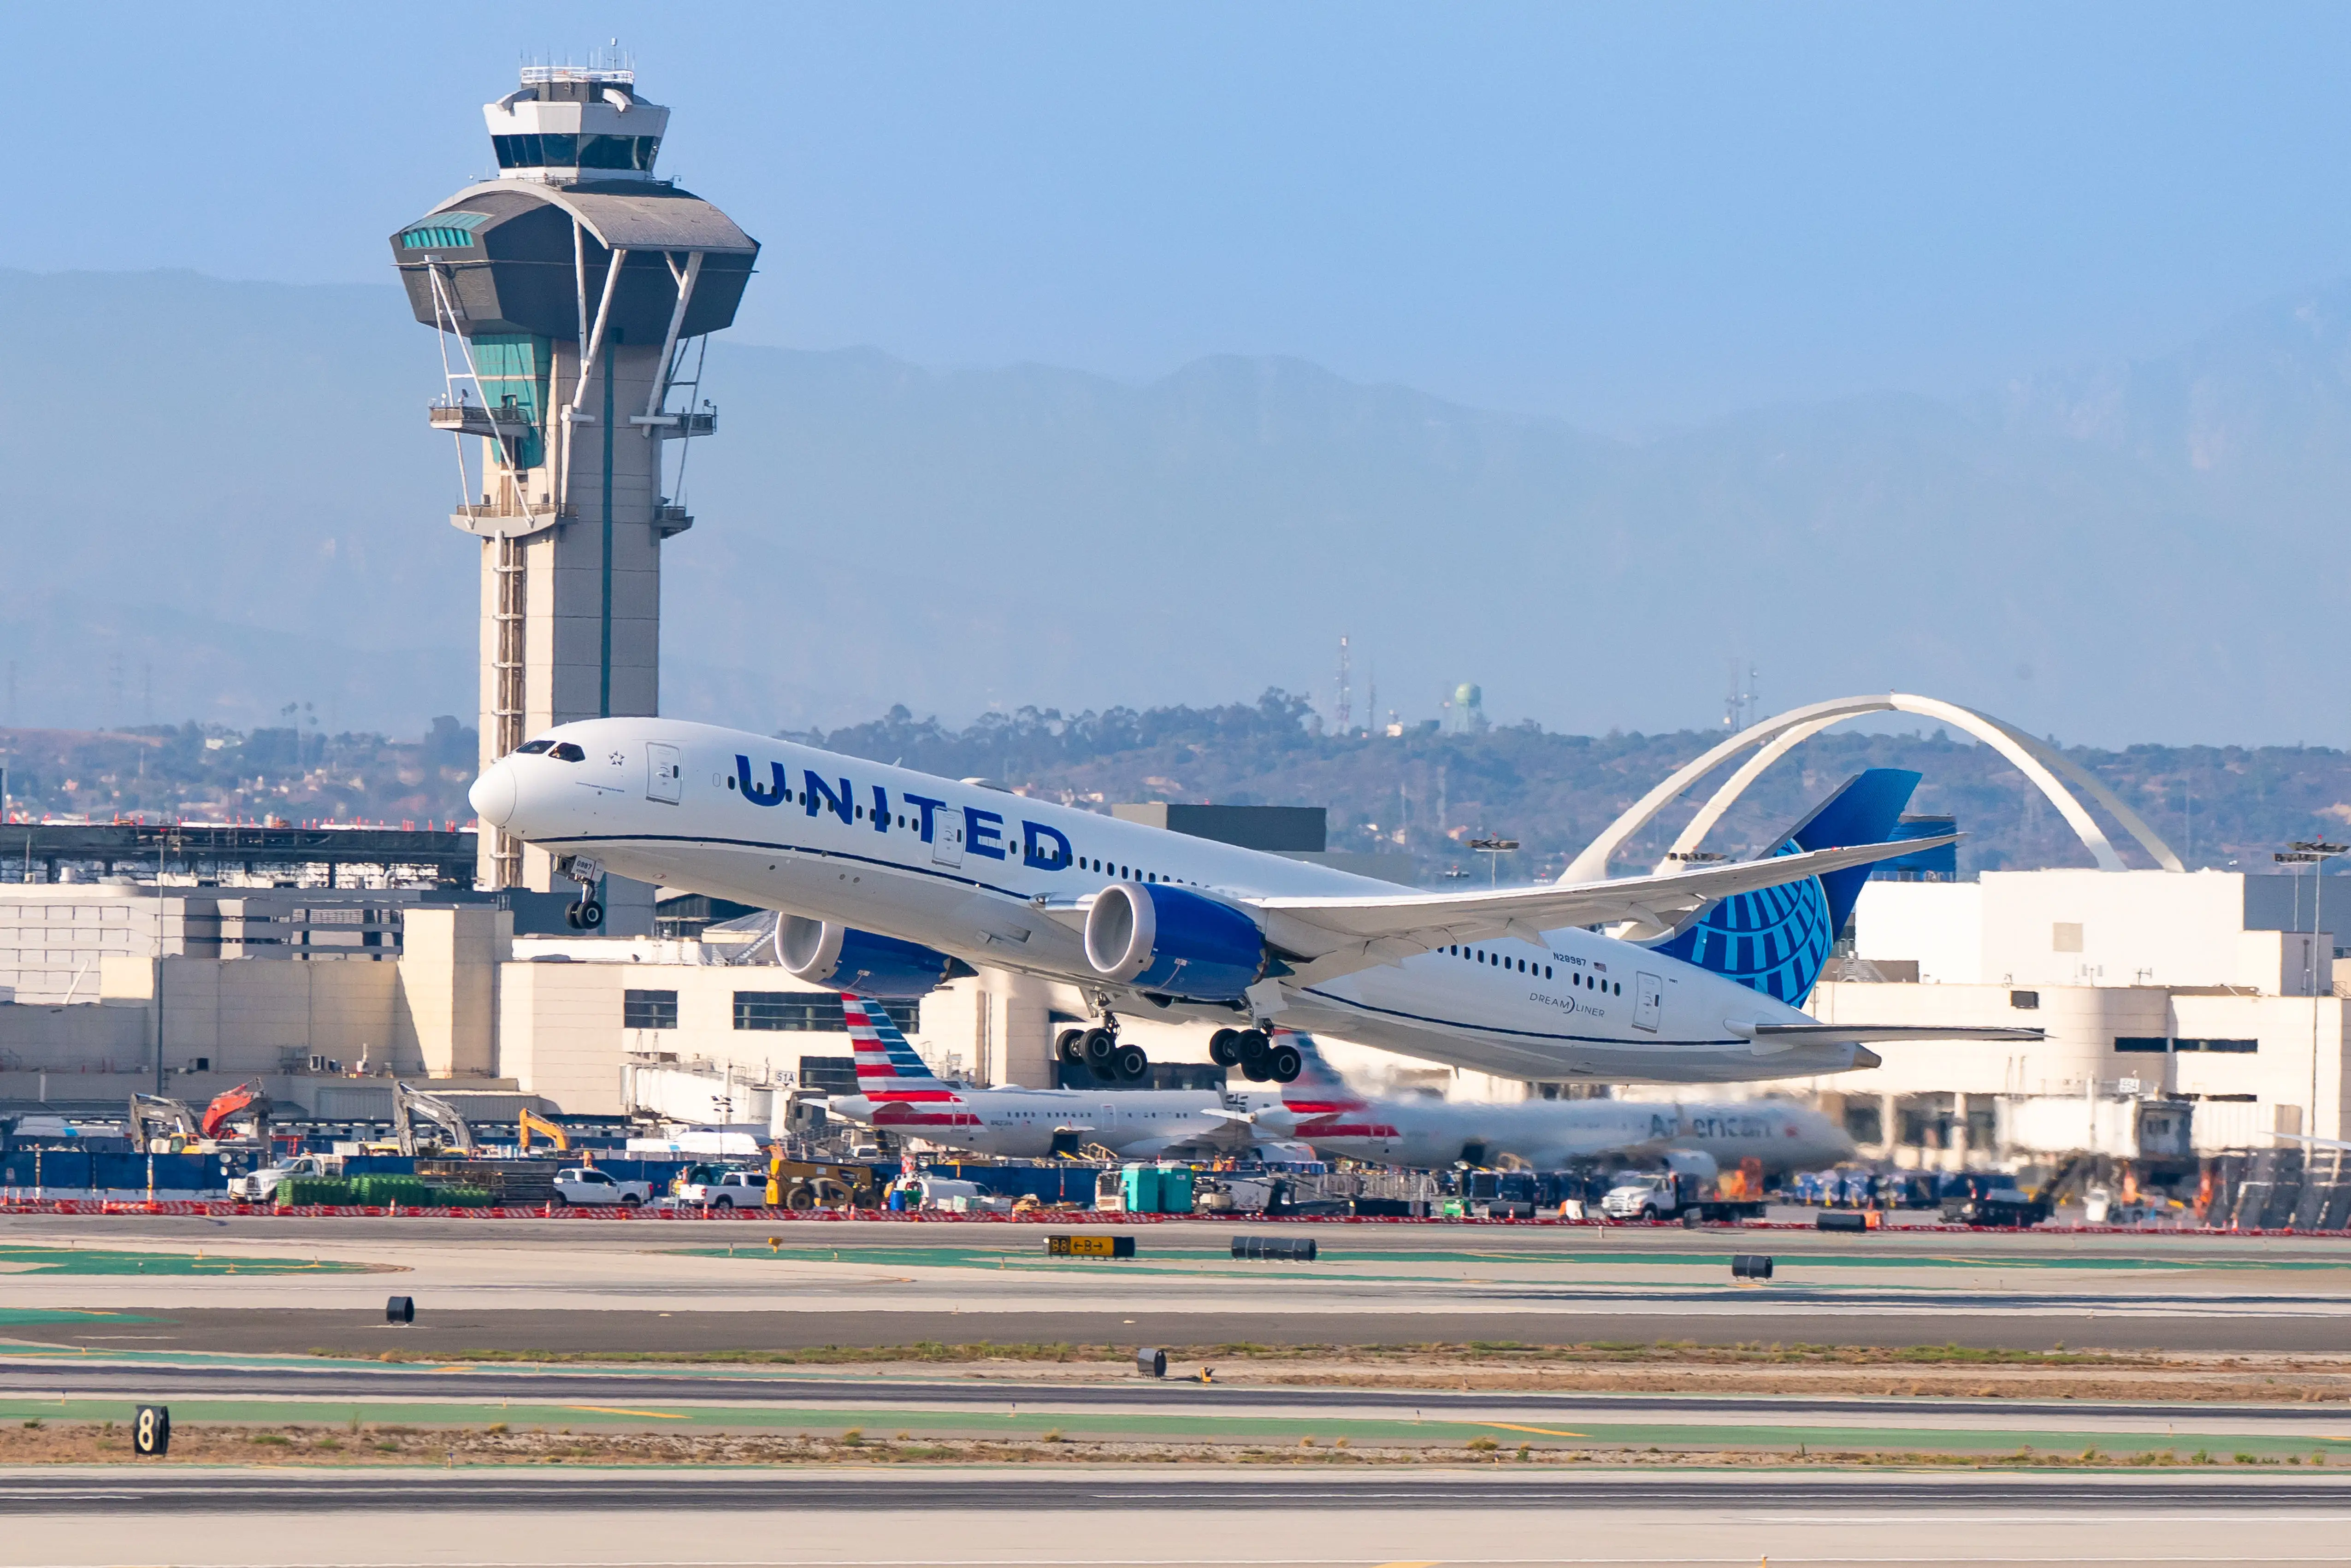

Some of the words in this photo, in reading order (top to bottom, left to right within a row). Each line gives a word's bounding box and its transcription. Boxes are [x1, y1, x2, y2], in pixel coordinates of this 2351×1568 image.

[734, 754, 1072, 871] UNITED
[1553, 952, 1586, 967] N28987
[1084, 1239, 1092, 1251] B
[138, 1409, 154, 1451] 8
